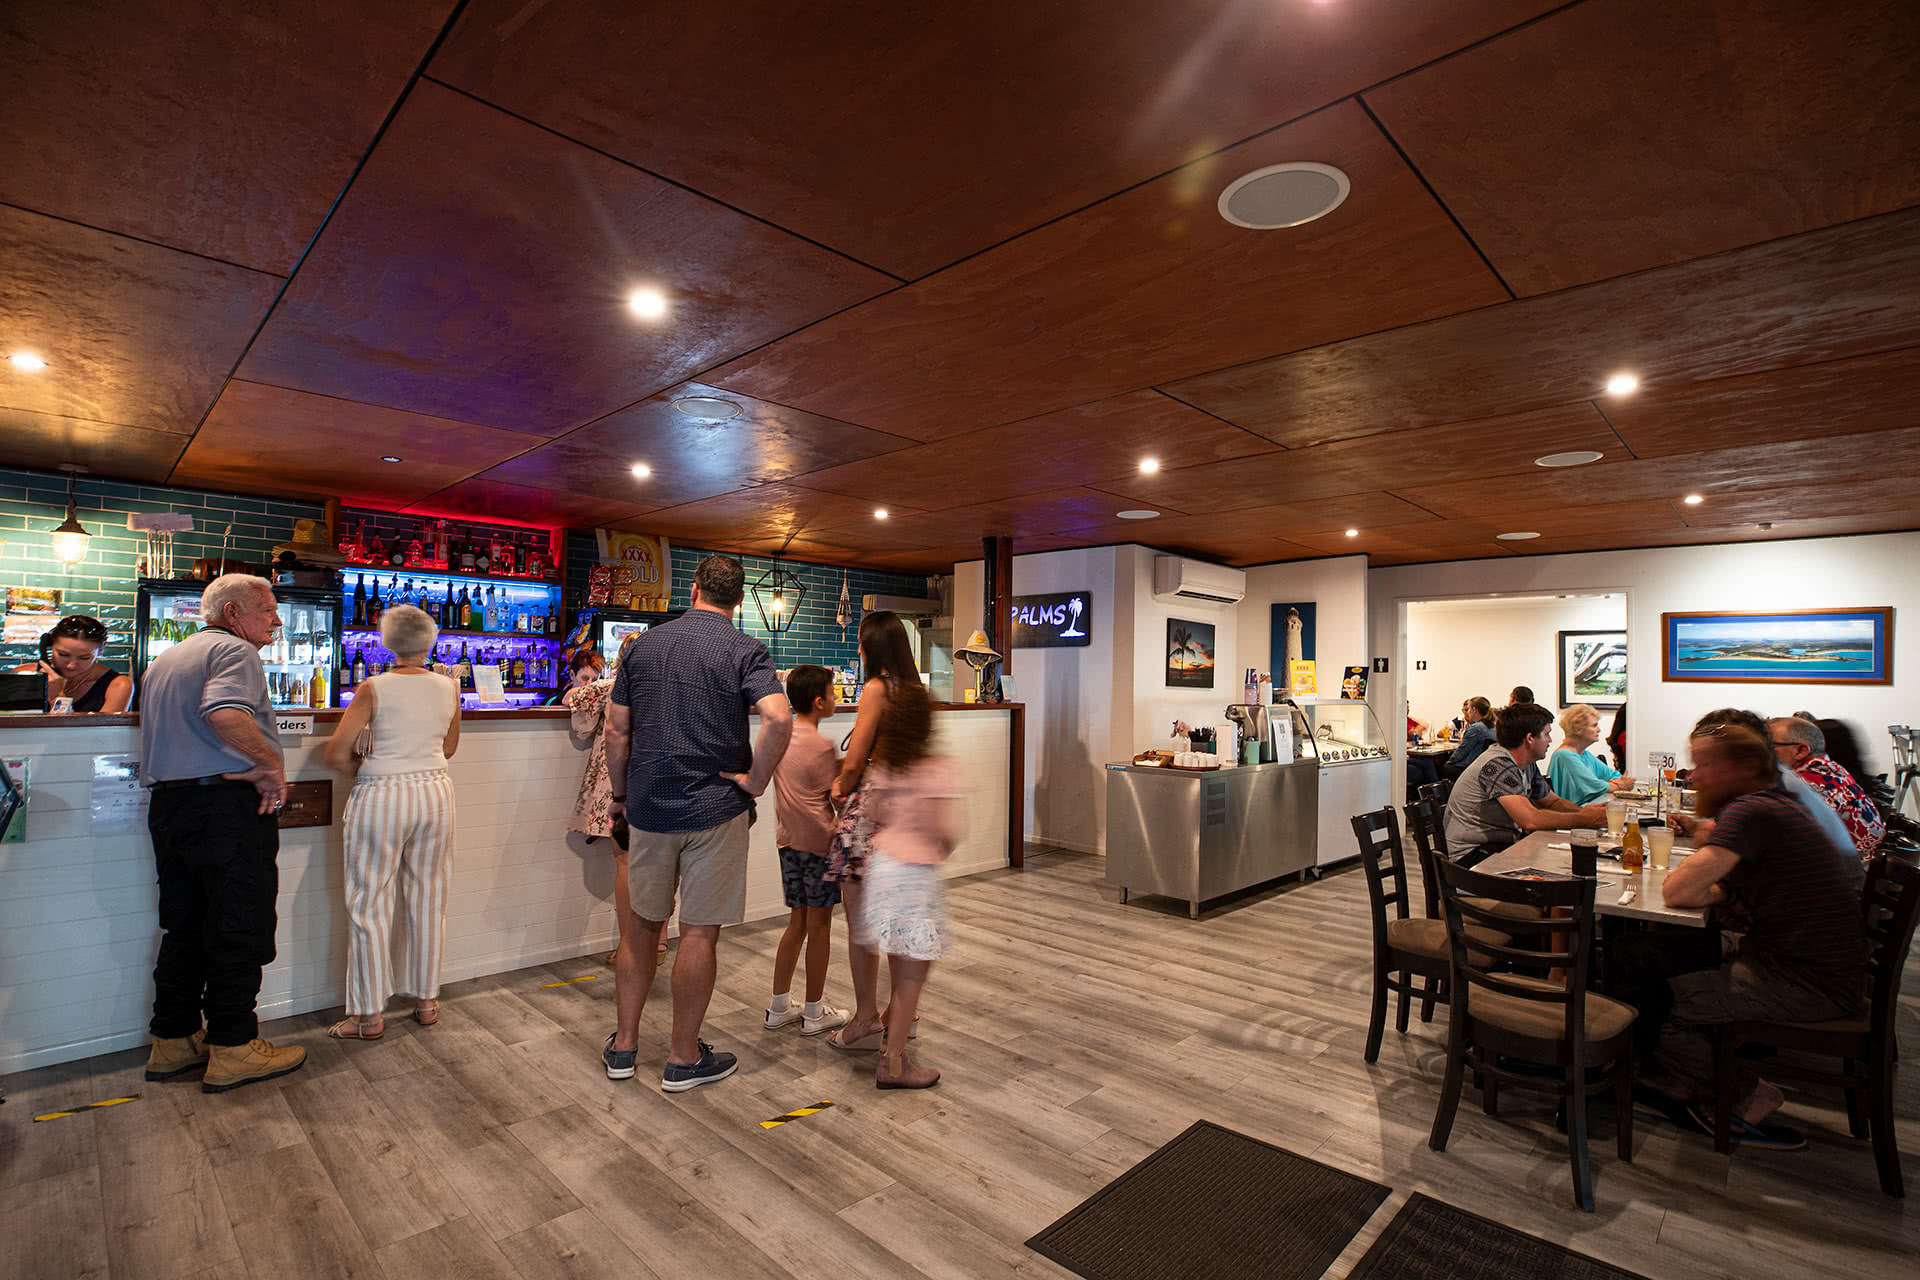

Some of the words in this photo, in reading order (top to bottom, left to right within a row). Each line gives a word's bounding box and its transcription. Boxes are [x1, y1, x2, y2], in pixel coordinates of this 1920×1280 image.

[622, 549, 652, 563] XXXX
[630, 565, 659, 583] OLD
[1011, 604, 1067, 626] PALMS
[1663, 756, 1675, 769] 30
